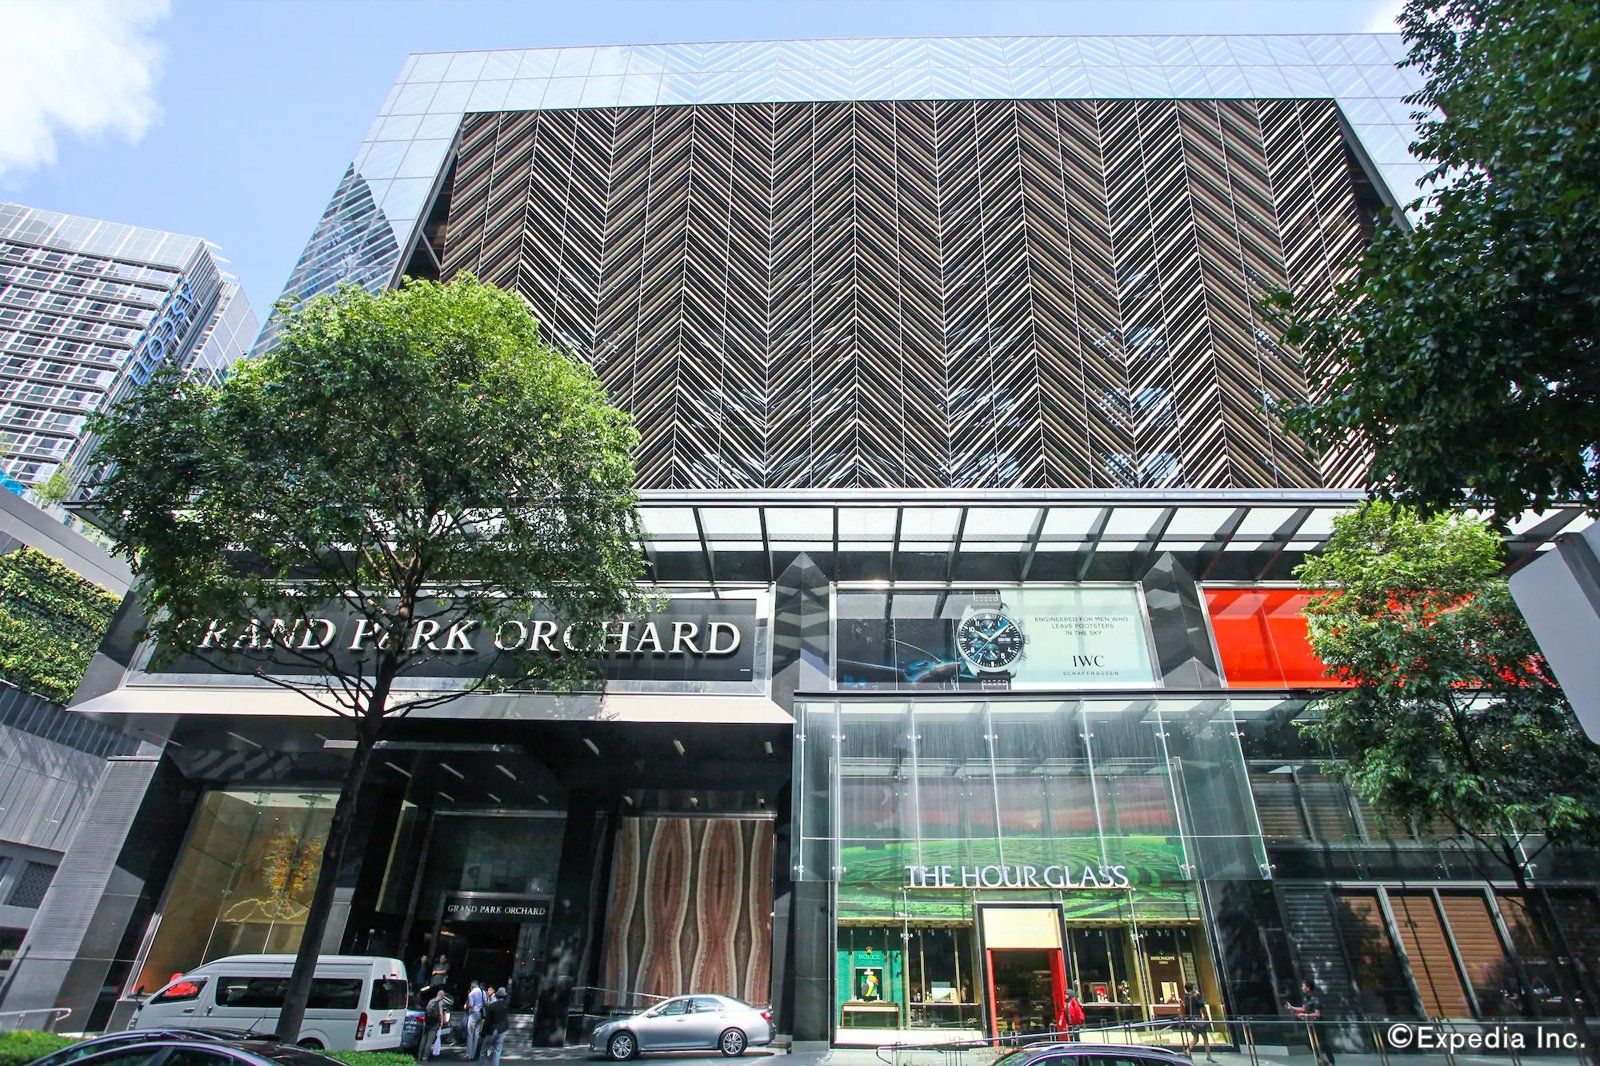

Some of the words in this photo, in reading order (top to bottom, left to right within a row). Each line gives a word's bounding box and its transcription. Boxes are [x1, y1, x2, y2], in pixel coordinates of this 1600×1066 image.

[127, 279, 195, 386] ASCOTT
[347, 619, 477, 651] PRK
[493, 620, 741, 655] ORCHARD
[1072, 655, 1104, 668] IWC
[904, 865, 956, 887] THE
[961, 865, 1038, 887] HOUR
[1043, 865, 1129, 887] GLASS
[447, 904, 478, 913] GRAND
[480, 904, 502, 914] PARK
[504, 906, 546, 916] ORCHARD
